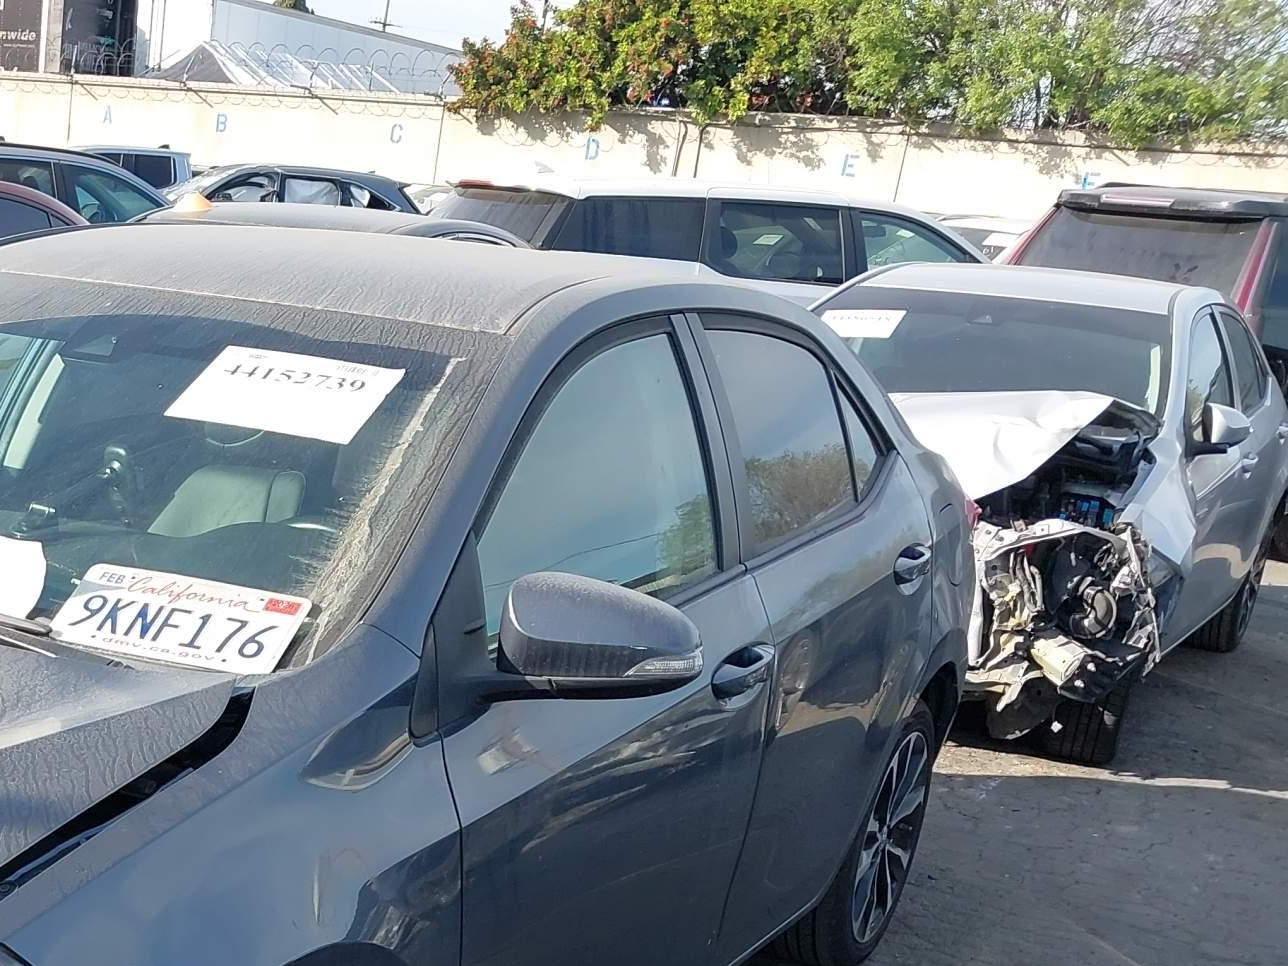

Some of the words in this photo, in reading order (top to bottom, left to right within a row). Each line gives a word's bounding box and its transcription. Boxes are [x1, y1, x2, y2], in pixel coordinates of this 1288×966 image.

[103, 104, 112, 124] A
[215, 113, 228, 132] B
[389, 123, 403, 144] C
[585, 135, 600, 160] D
[841, 153, 860, 177] E
[224, 364, 366, 392] 44152739
[98, 571, 126, 585] FEB
[126, 576, 261, 614] California
[68, 594, 279, 659] 9KNF176
[101, 635, 216, 662] dmv.ca.gov
